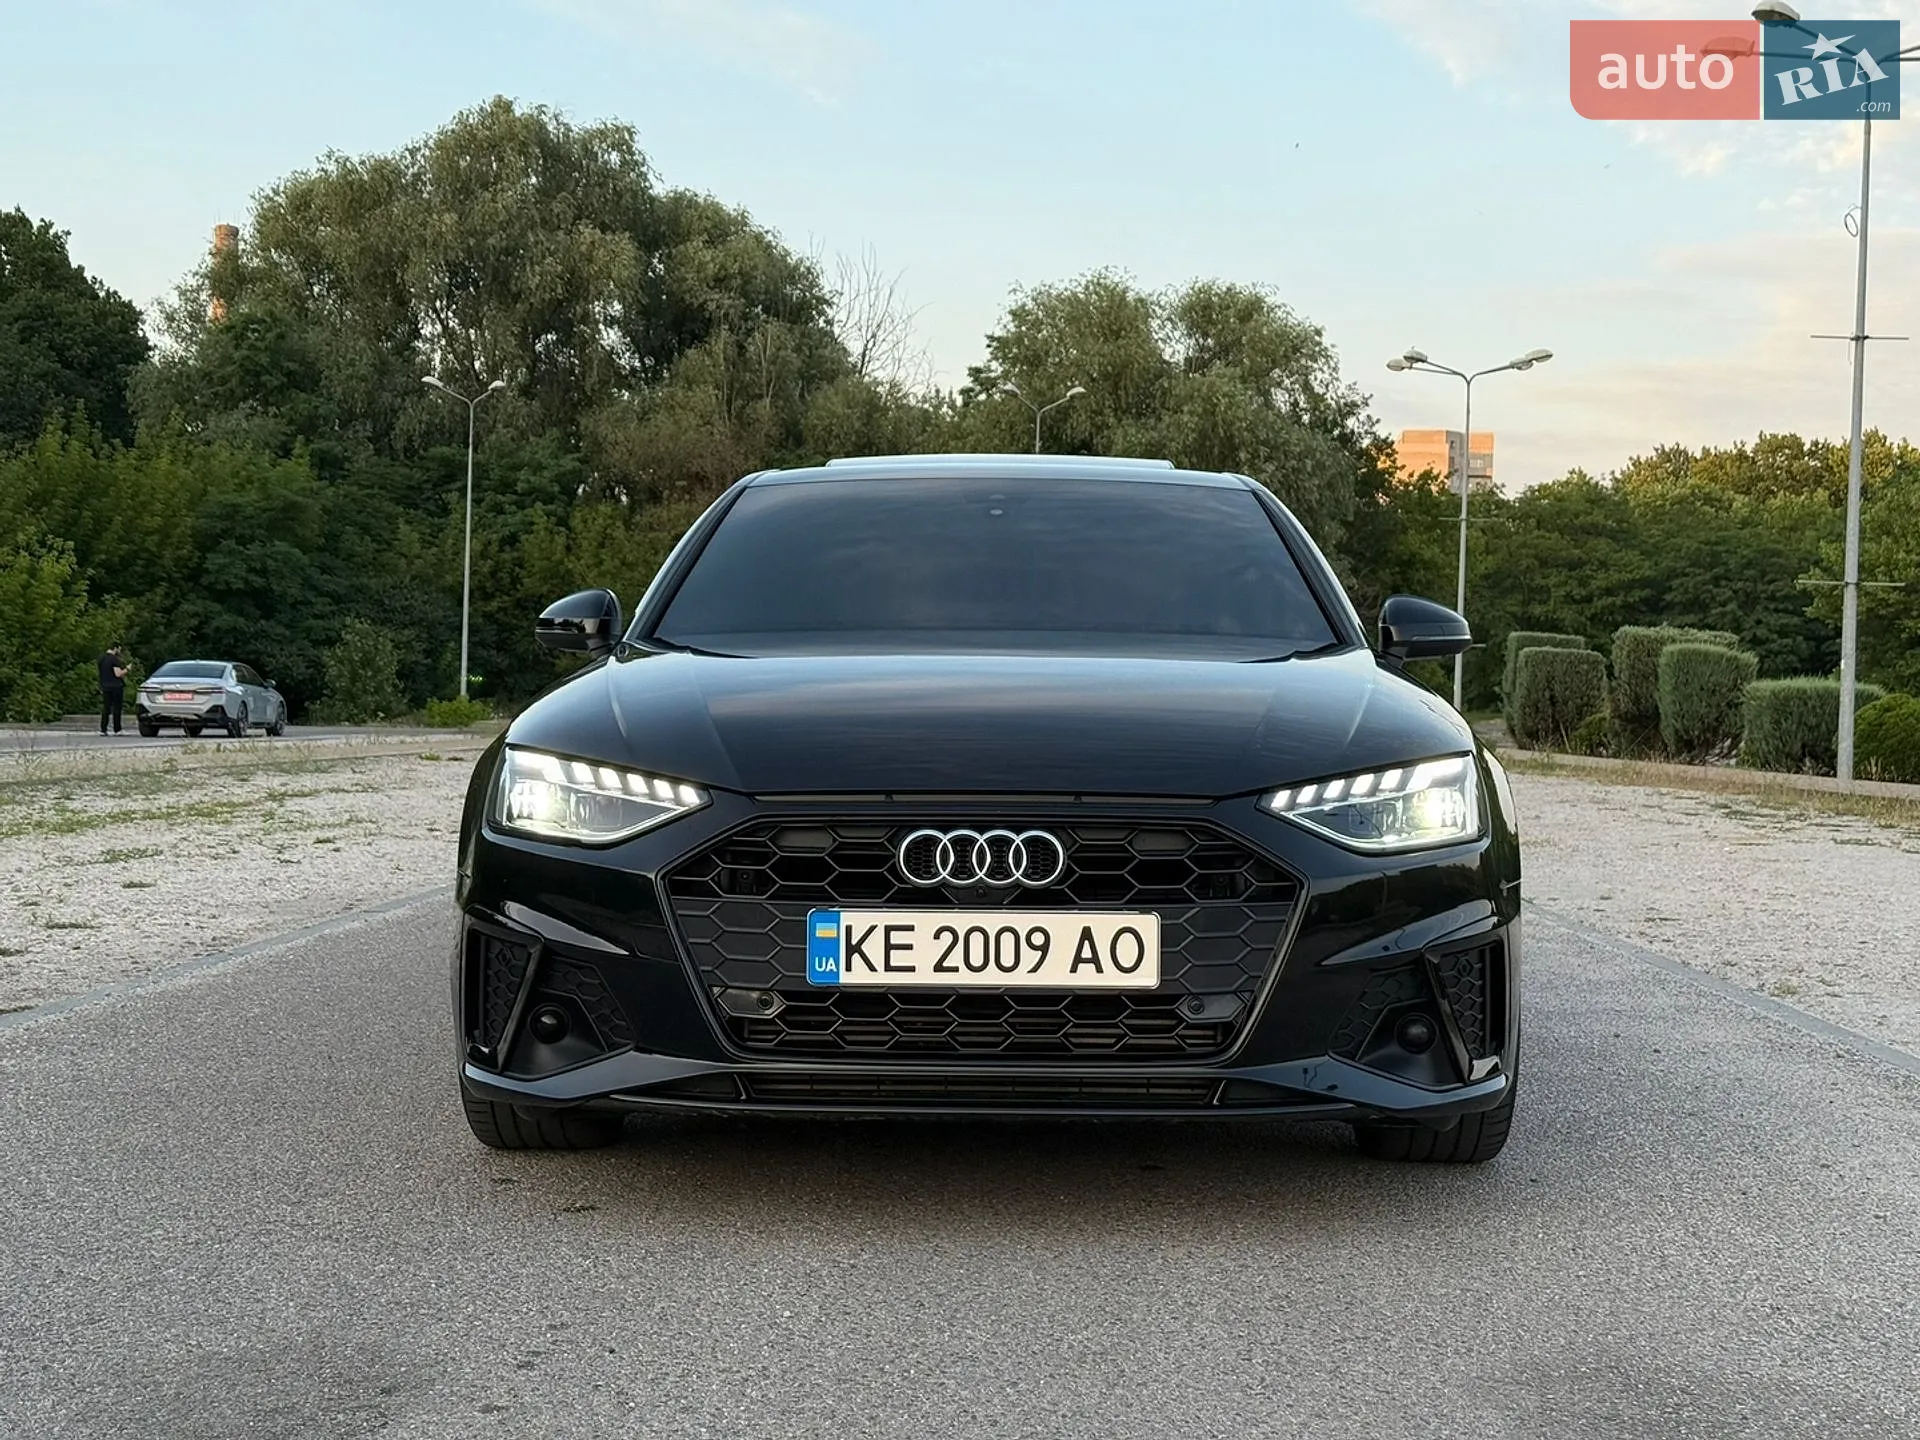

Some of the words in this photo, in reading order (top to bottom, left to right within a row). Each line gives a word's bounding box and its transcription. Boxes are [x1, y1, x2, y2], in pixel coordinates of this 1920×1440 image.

[815, 957, 837, 972] UA
[845, 924, 916, 973] KE
[933, 925, 1051, 974] 2009
[1069, 925, 1146, 974] AO
